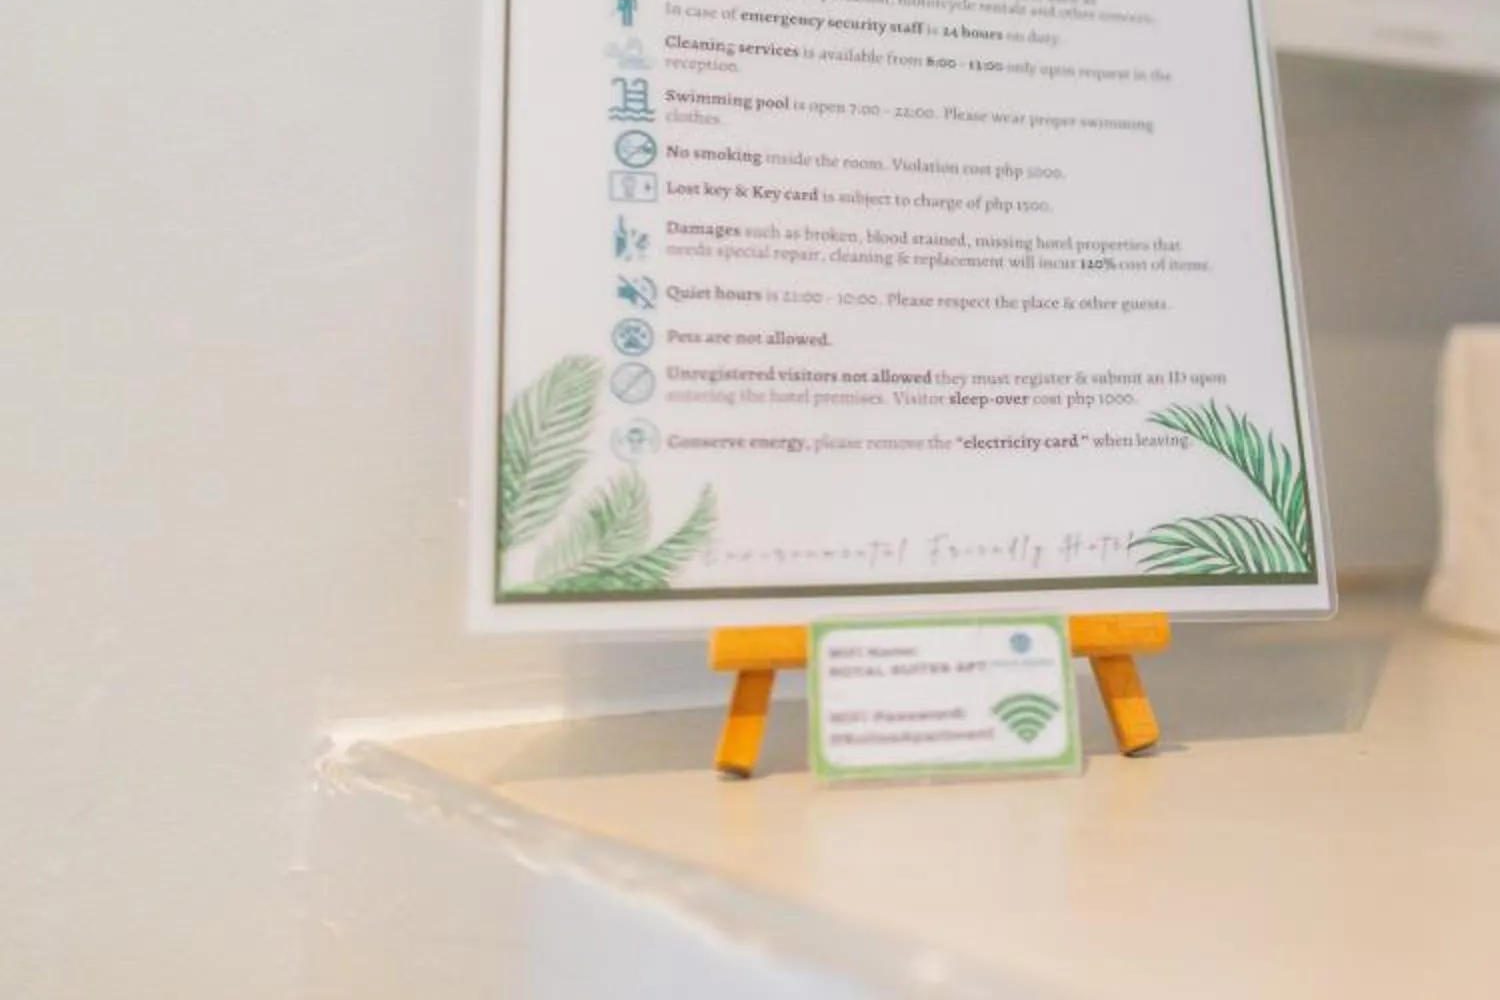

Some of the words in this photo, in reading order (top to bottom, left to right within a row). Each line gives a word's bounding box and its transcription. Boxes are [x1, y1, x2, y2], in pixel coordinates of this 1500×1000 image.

[666, 2, 681, 16] In
[721, 7, 737, 20] of
[740, 12, 825, 30] emergency
[827, 19, 886, 35] security
[890, 21, 923, 35] staff
[961, 25, 1003, 40] hours
[665, 35, 735, 56] Cleaning
[739, 44, 798, 58] services
[819, 49, 882, 64] available
[886, 52, 922, 67] from
[665, 88, 752, 110] Swimming
[756, 97, 789, 111] pool
[809, 102, 846, 115] open
[944, 107, 987, 121] Please
[666, 145, 689, 159] No
[694, 148, 762, 166] smoking
[815, 154, 839, 167] the
[892, 158, 959, 174] Violation
[996, 164, 1023, 180] php
[666, 182, 699, 196] Lost
[703, 184, 730, 201] key
[735, 185, 748, 199] &
[752, 186, 781, 203] Key
[784, 189, 818, 202] card
[839, 191, 891, 207] subject
[895, 195, 910, 206] to
[913, 194, 963, 211] charge
[966, 197, 984, 209] of
[985, 197, 1013, 214] php
[666, 221, 740, 240] Damages
[745, 226, 780, 239] such
[785, 231, 799, 240] as
[866, 230, 907, 245] blood
[975, 235, 1032, 251] missing
[1036, 236, 1073, 249] hotel
[1076, 239, 1149, 253] properties
[1153, 238, 1182, 251] that
[829, 250, 893, 267] cleaning
[914, 253, 1003, 269] replacement
[1008, 255, 1035, 268] will
[1151, 258, 1168, 270] of
[666, 286, 711, 301] Quiet
[715, 288, 762, 302] hours
[887, 293, 934, 307] Please
[937, 297, 990, 310] respect
[995, 296, 1019, 308] the
[1022, 296, 1060, 312] place
[1064, 297, 1075, 309] &
[1079, 297, 1118, 310] other
[667, 330, 700, 343] Pets
[705, 334, 731, 343] are
[736, 332, 761, 344] not
[766, 331, 832, 345] allowed.
[666, 366, 774, 383] Unregistered
[778, 369, 837, 382] visitors
[842, 371, 867, 383] not
[872, 370, 931, 383] allowed
[936, 371, 966, 387] they
[971, 373, 1009, 384] must
[1014, 372, 1071, 387] register
[1075, 372, 1087, 384] &
[1091, 372, 1141, 384] submit
[1146, 375, 1164, 384] an
[1190, 375, 1227, 387] upon
[949, 393, 1028, 408] sleep-over
[1032, 394, 1060, 405] cost
[1067, 393, 1094, 408] php
[1045, 435, 1079, 448] card
[1093, 435, 1134, 447] when
